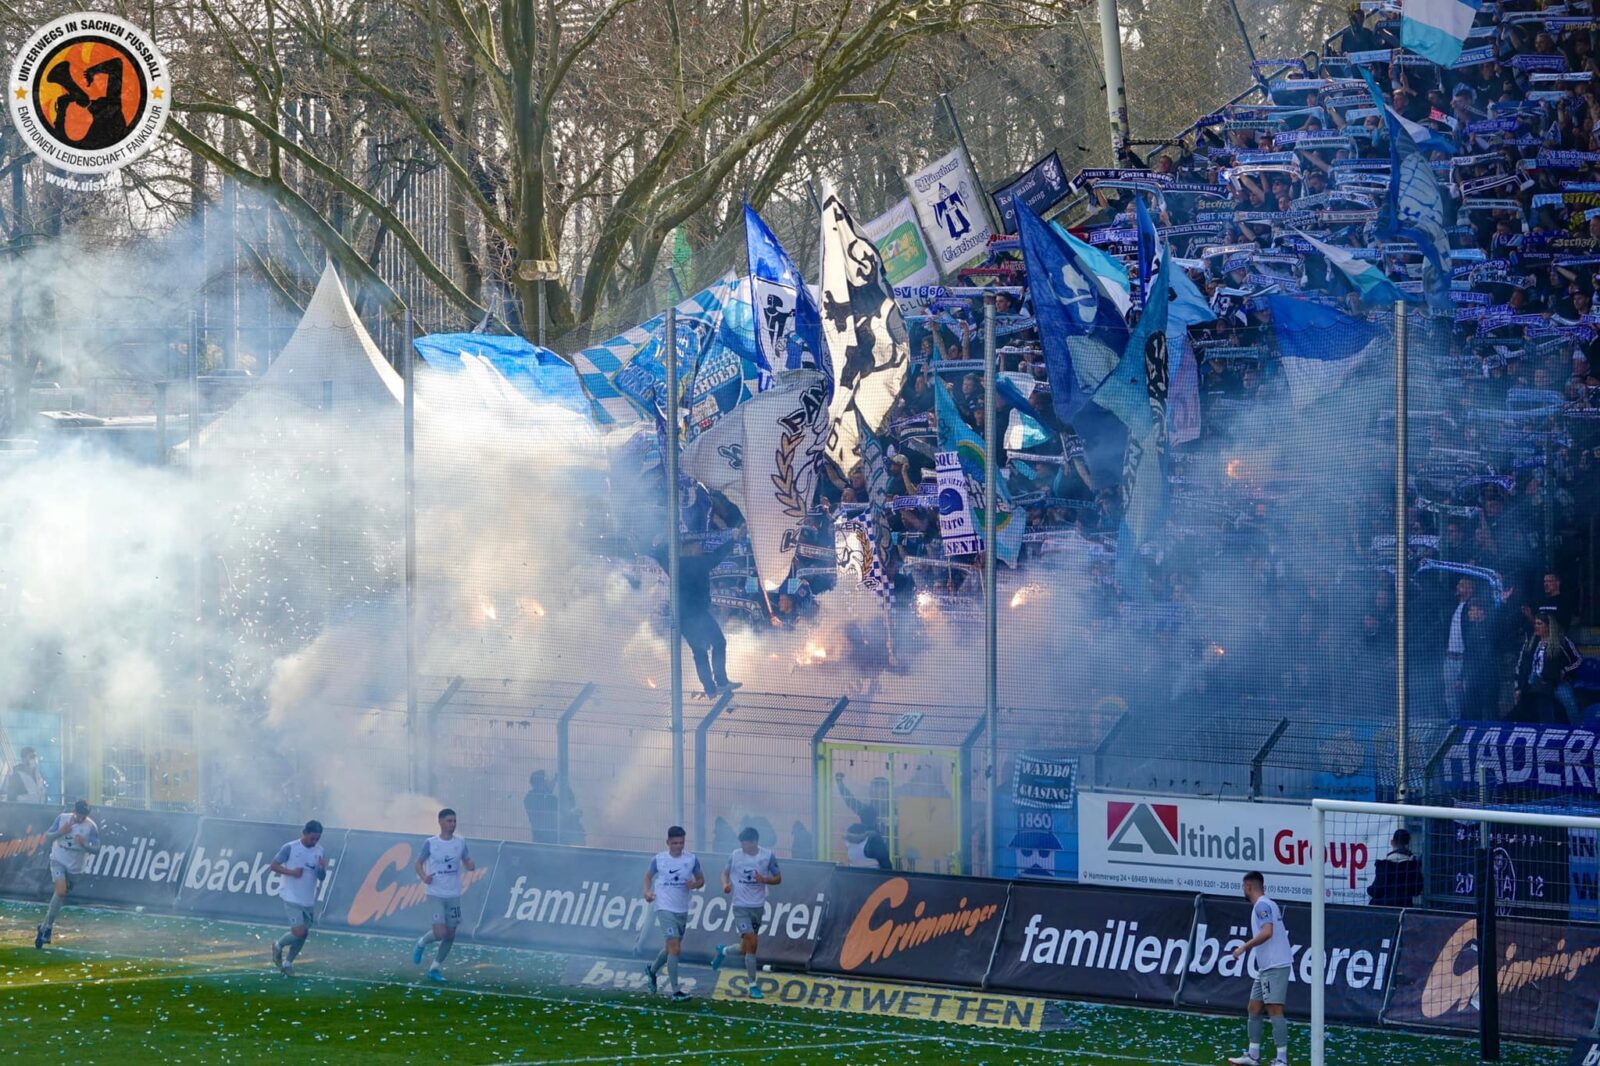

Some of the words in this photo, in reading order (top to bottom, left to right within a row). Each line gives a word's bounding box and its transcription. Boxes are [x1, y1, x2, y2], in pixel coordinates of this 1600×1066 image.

[1021, 761, 1071, 778] WAMBO
[1020, 812, 1052, 830] 1860
[1107, 801, 1265, 862] Altindal
[1273, 829, 1368, 889] Grup
[839, 877, 998, 971] Grimminger
[724, 974, 1035, 1029] SPORTWETTEN
[1421, 918, 1600, 1019] Gimminger
